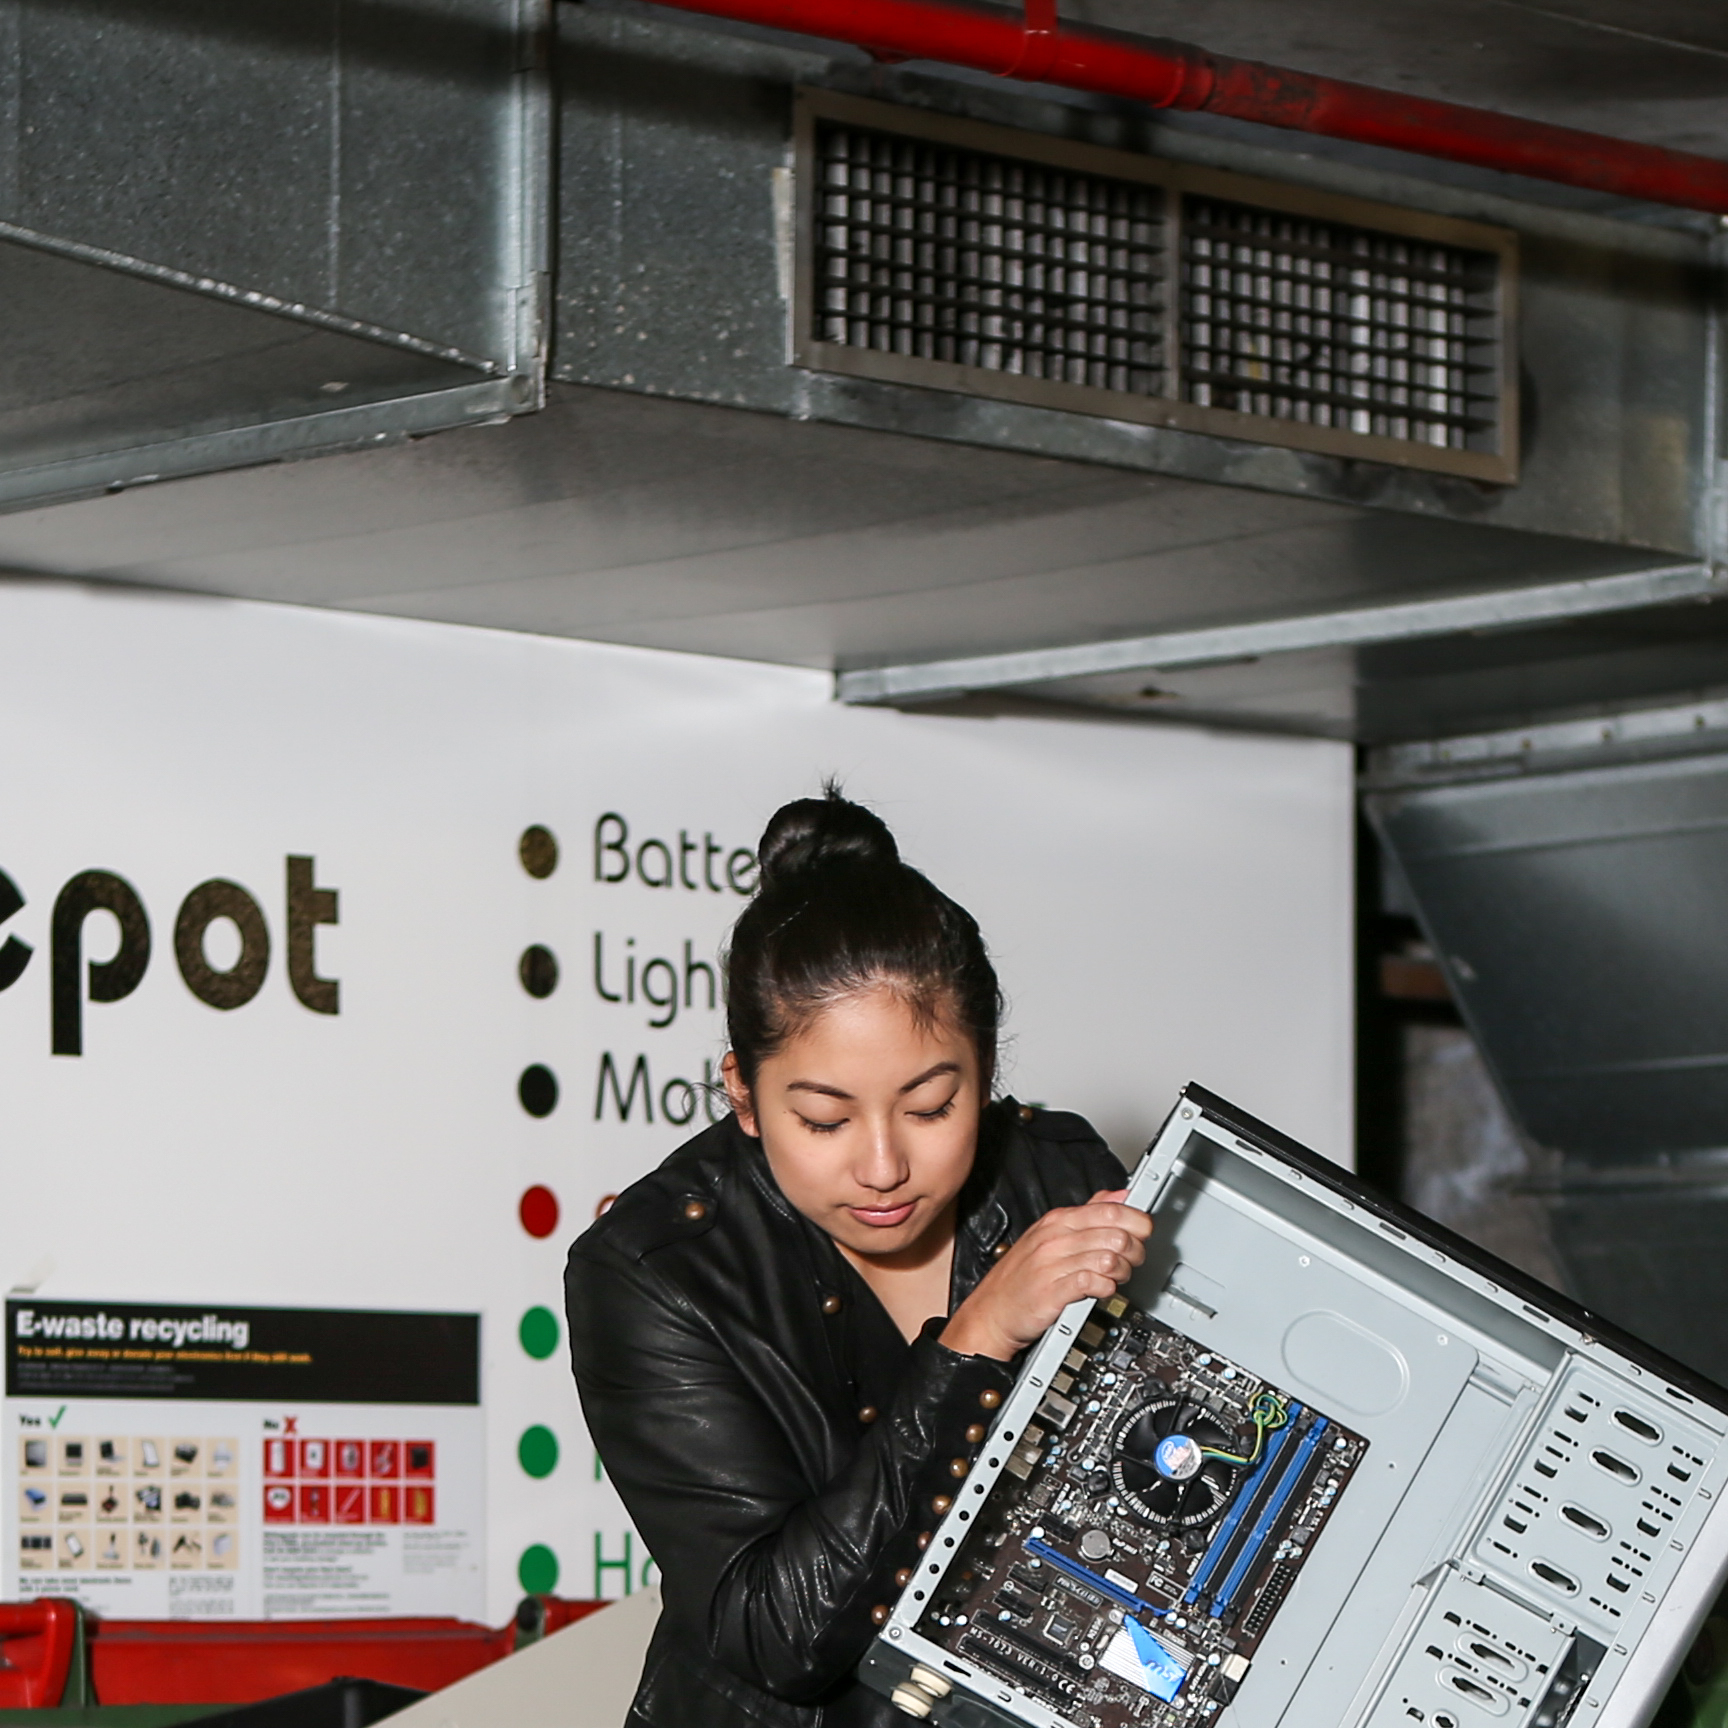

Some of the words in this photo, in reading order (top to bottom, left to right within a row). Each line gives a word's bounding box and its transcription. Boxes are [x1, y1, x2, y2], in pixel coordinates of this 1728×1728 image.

[16, 1310, 125, 1340] E-waste
[130, 1314, 250, 1349] recycling
[18, 1414, 41, 1427] Yes
